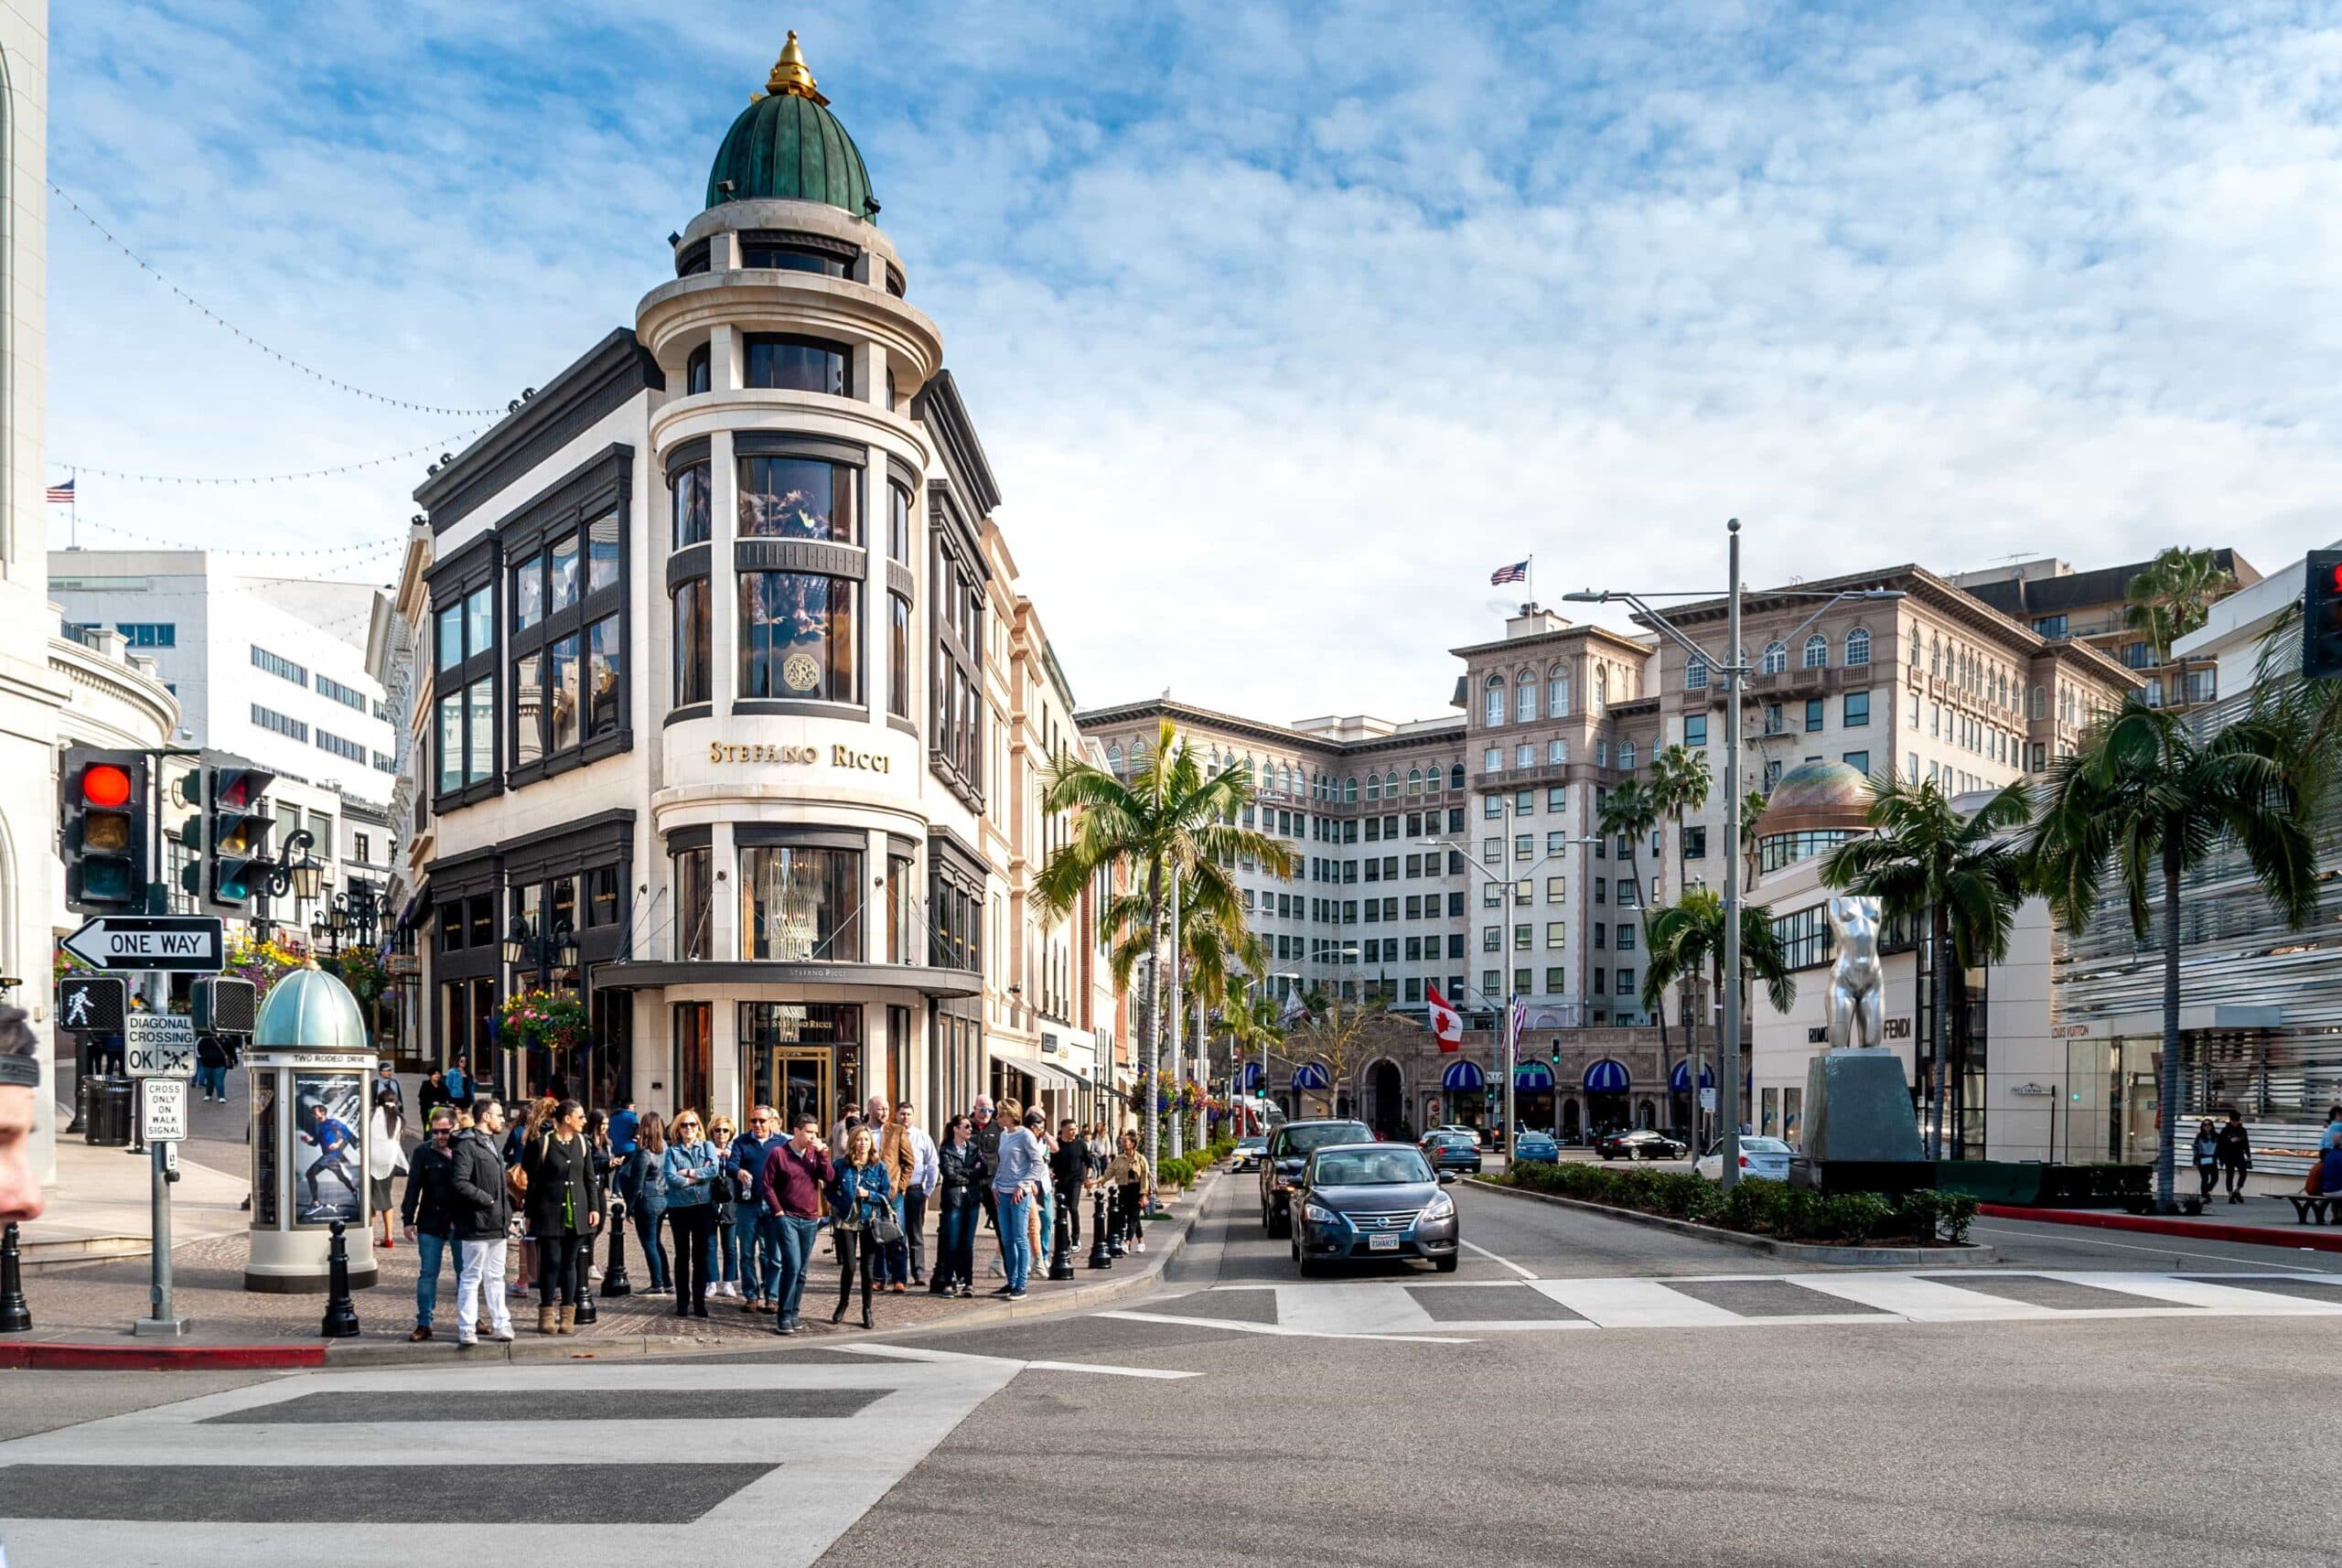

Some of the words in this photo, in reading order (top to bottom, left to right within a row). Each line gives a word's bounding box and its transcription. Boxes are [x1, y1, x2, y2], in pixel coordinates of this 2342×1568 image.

[709, 741, 820, 765] STEFANO
[832, 744, 891, 774] RICCI
[111, 934, 151, 953] ONE
[161, 934, 201, 953] WAY
[825, 969, 846, 977] RICCI
[130, 1017, 191, 1029] DIAGONAL
[809, 1020, 833, 1029] RICCI
[1884, 1017, 1910, 1039] FENDI
[129, 1031, 193, 1044] CROSSING
[1809, 1026, 1830, 1044] RIMO
[2051, 1026, 2066, 1039] LOUIS
[2067, 1025, 2090, 1037] VUITTON
[129, 1050, 154, 1069] OK
[294, 1054, 313, 1062] TWO
[148, 1085, 180, 1093] CROSS
[153, 1095, 177, 1103] ONLY
[153, 1116, 177, 1124] WALK
[148, 1126, 181, 1134] SIGNAL
